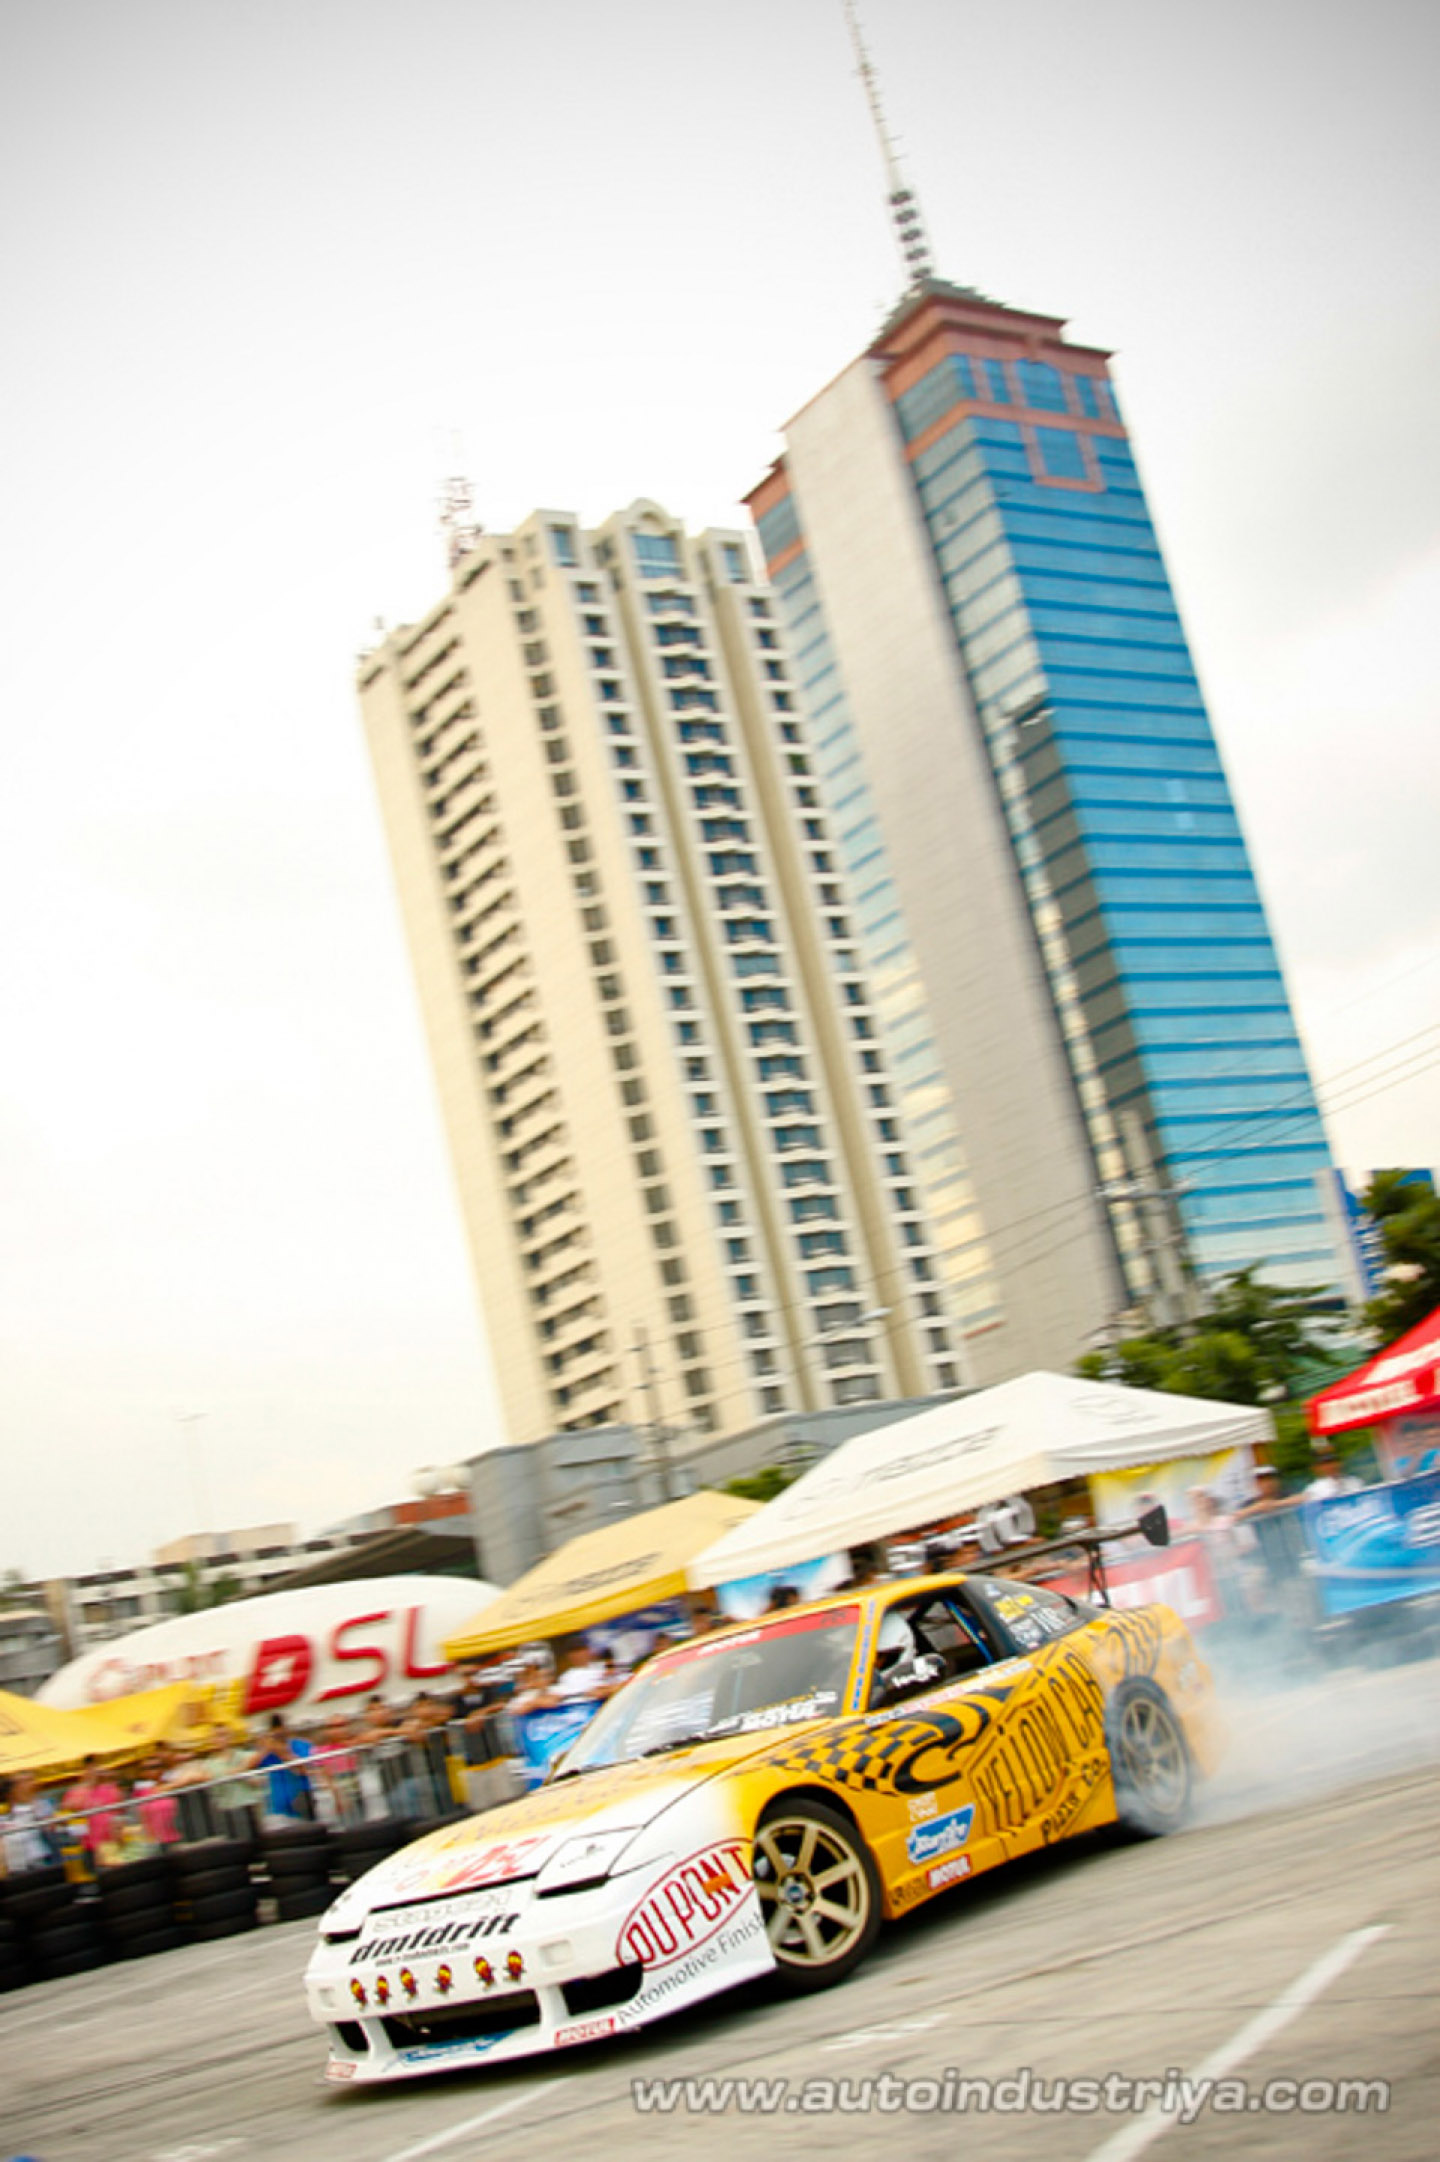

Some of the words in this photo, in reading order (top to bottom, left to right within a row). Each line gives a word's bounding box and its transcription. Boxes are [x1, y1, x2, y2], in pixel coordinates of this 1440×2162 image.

[243, 1605, 457, 1715] DSL
[348, 1912, 521, 1966] dmfdrift
[617, 1946, 718, 2024] Automotive
